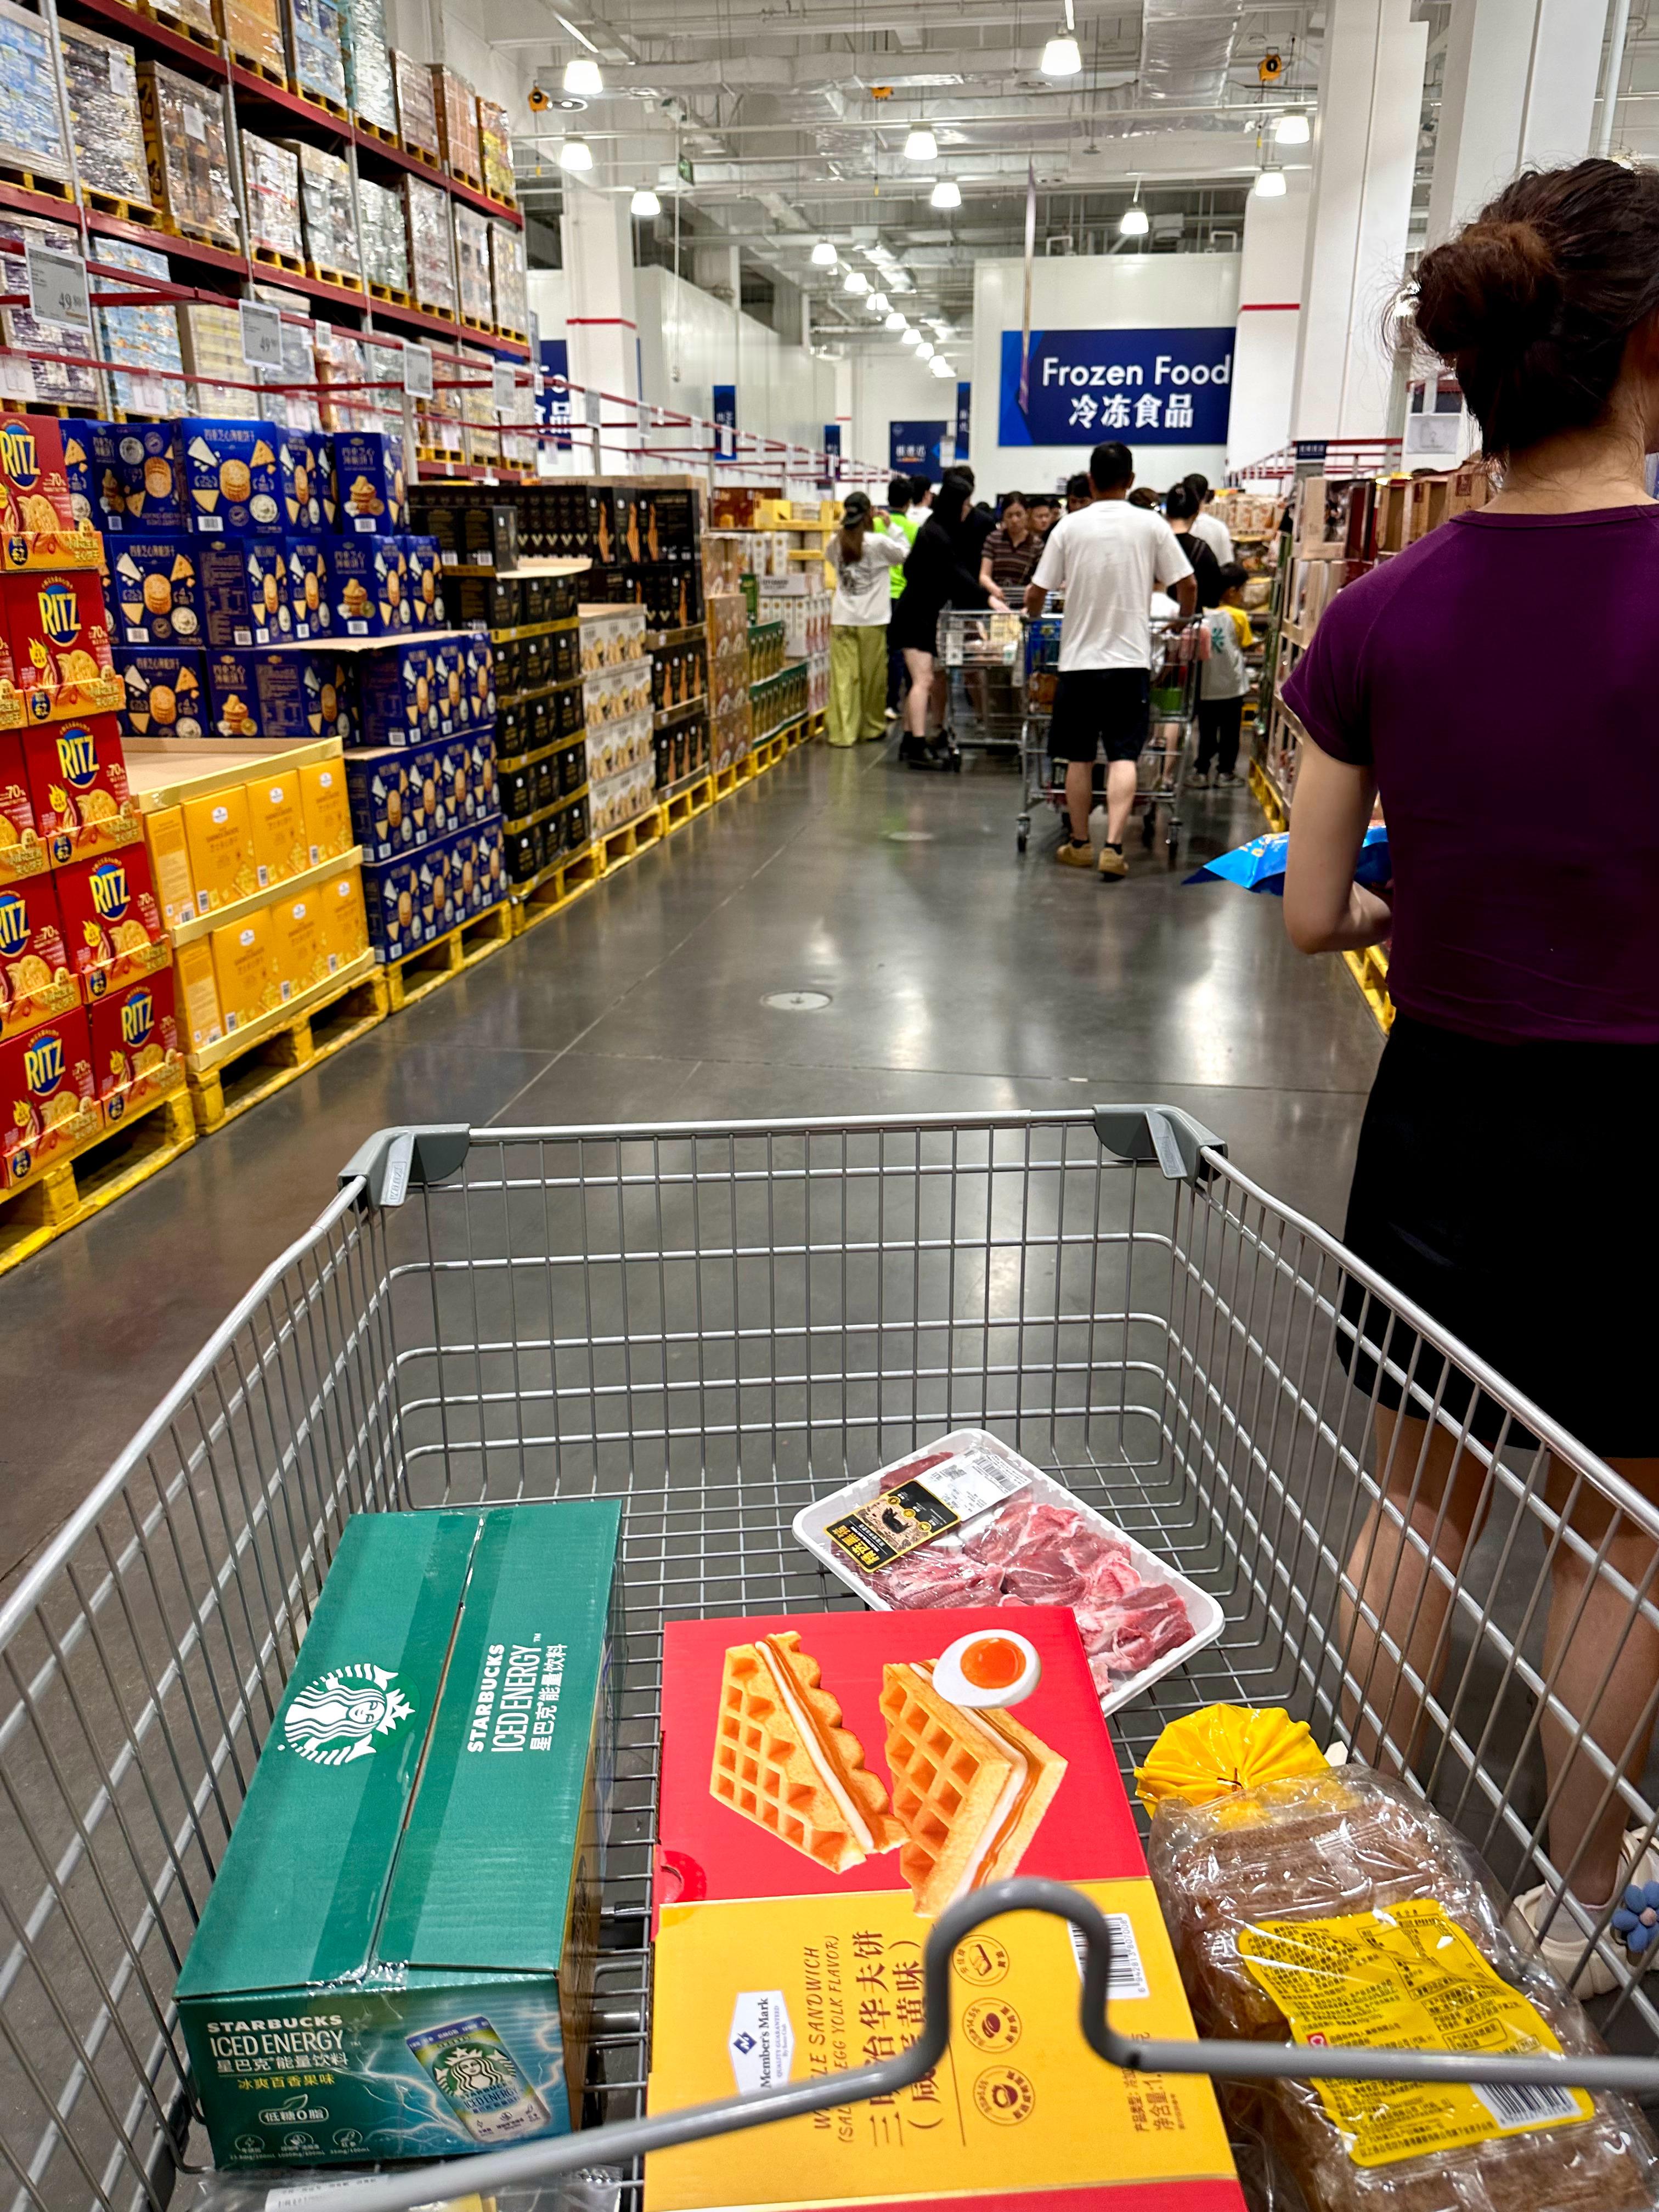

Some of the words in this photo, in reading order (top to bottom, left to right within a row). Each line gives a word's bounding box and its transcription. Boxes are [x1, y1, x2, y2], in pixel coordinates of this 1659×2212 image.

[1043, 357, 1143, 386] Frozen
[1155, 355, 1231, 386] Food
[1069, 393, 1194, 428] 冷冻食品
[0, 430, 41, 477] RITZ
[37, 592, 82, 635] RITZ
[56, 735, 100, 779] RITZ
[89, 868, 131, 913] RITZ
[121, 995, 155, 1042] RITZ
[24, 1039, 66, 1091] RITZ
[467, 1644, 505, 1752] STARBUCKS
[500, 1645, 541, 1709] ENERGY
[491, 1713, 528, 1752] ICED
[825, 1936, 842, 1992] FLAVOR)
[757, 1997, 769, 2030] Mark
[804, 1947, 826, 2046] SANDWICH
[829, 1999, 845, 2034] YOLK
[207, 2015, 343, 2033] STARBUCKS
[210, 2035, 259, 2057] ICED
[261, 2030, 343, 2055] ENERGY
[759, 2032, 772, 2089] Member's
[833, 2041, 848, 2069] EGG
[237, 2073, 335, 2090] 冰爽百香果味
